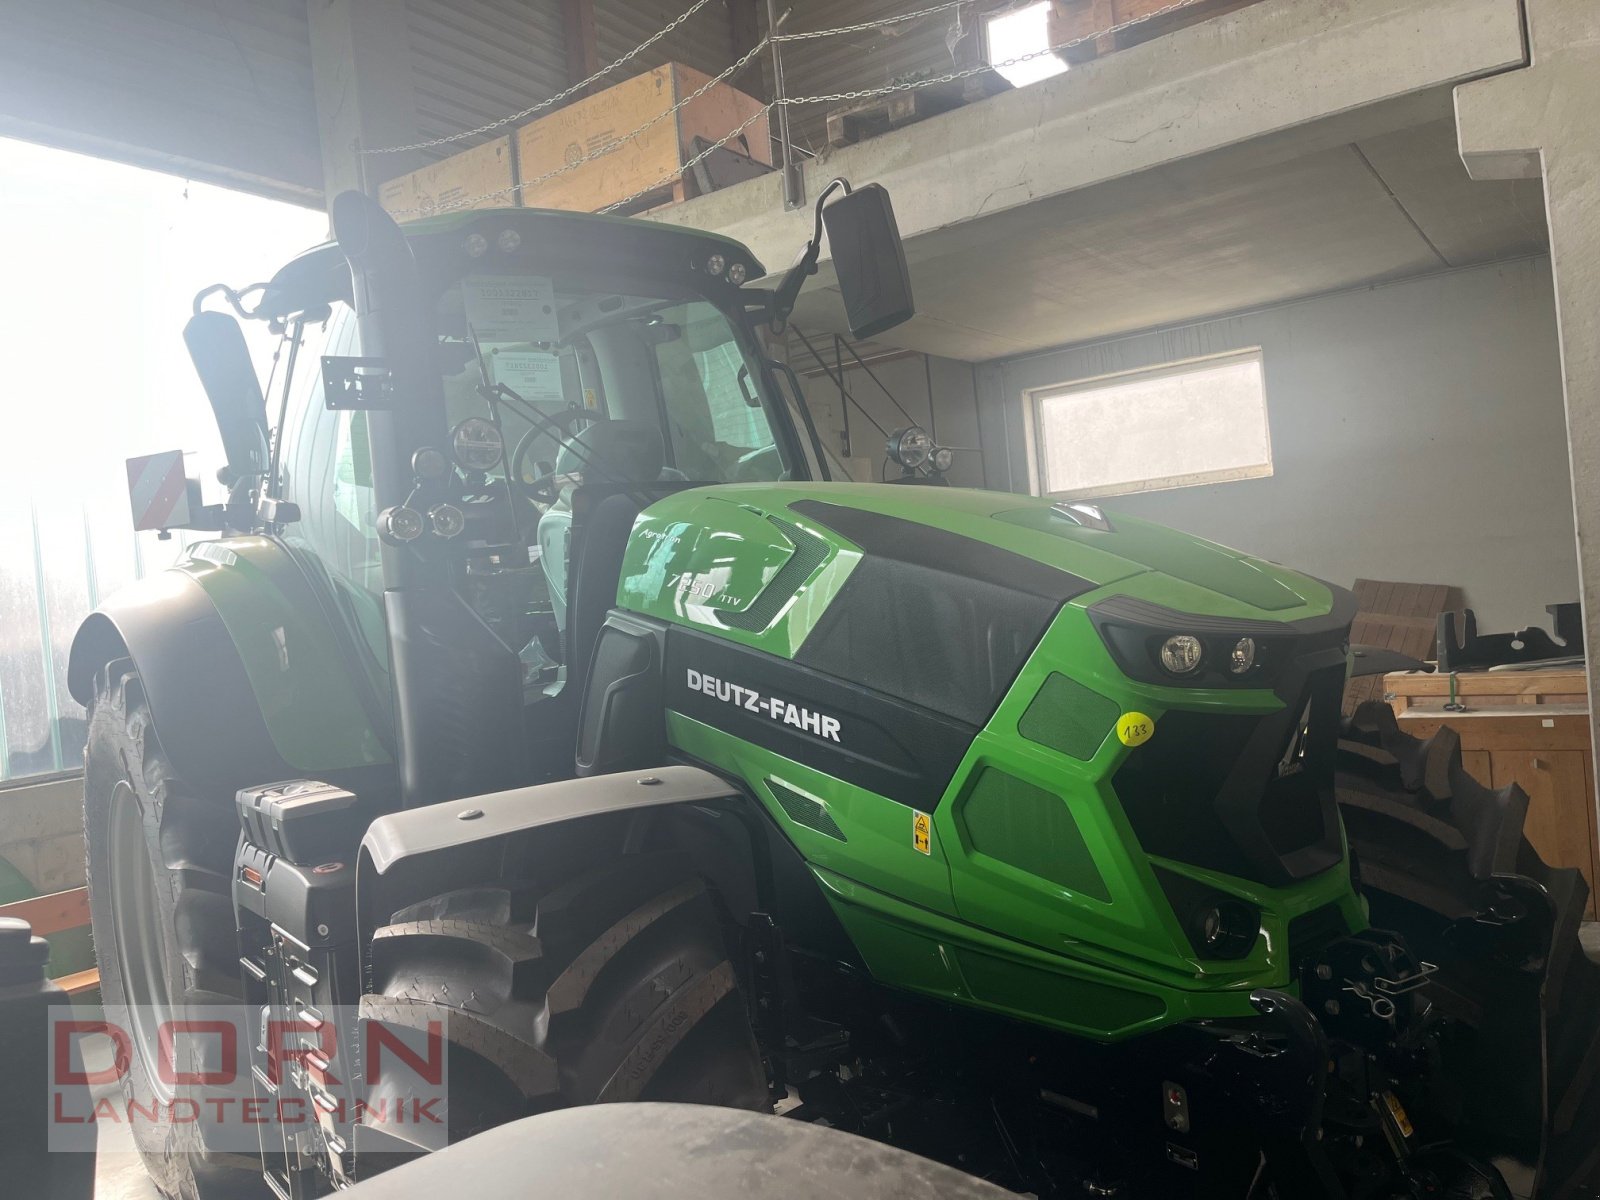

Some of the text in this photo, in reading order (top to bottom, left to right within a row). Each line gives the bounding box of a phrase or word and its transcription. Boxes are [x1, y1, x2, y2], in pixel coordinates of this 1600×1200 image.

[639, 528, 681, 544] Agrotron
[667, 574, 742, 606] 7250 TTV
[687, 668, 841, 742] DEUTZ-FAHR
[1124, 724, 1148, 738] 133
